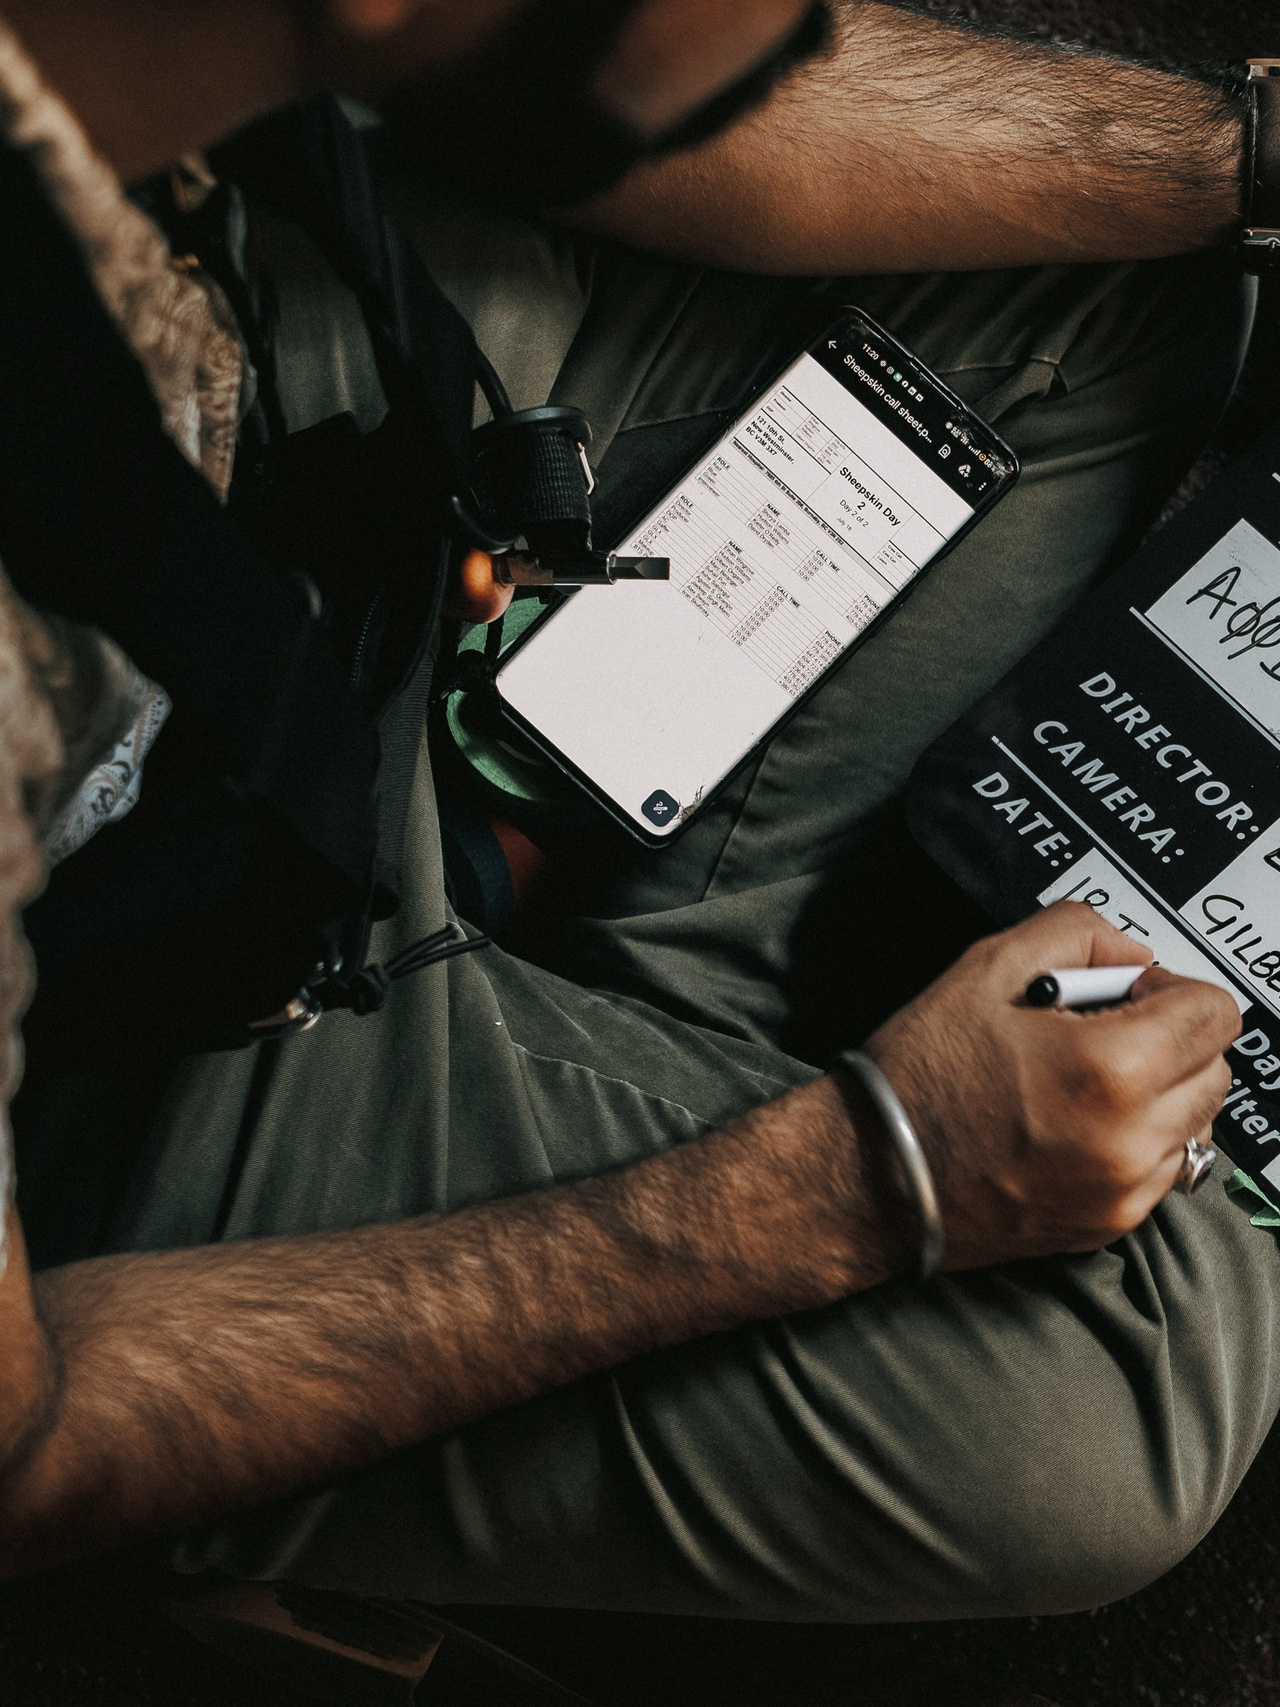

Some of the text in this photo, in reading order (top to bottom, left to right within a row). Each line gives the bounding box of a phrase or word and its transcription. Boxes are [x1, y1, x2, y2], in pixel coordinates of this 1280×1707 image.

[862, 343, 879, 360] 11:20
[843, 354, 884, 396] Sheepskin
[883, 393, 901, 409] call
[756, 415, 766, 425] 121
[766, 424, 778, 437] 10th
[745, 426, 777, 455] BC V3M 3X7
[750, 420, 763, 433] New
[762, 431, 794, 464] Westminster,
[839, 466, 900, 526] Sheepskin Day
[856, 501, 865, 510] 2
[766, 503, 780, 516] NAME
[839, 499, 852, 512] Day
[855, 515, 864, 523] of
[728, 540, 742, 554] NAME
[815, 549, 840, 572] CALL TIME
[776, 585, 800, 608] CALL TIME
[1079, 672, 1260, 840] DIRECTOR:
[1033, 720, 1185, 863] CAMERA:
[972, 772, 1073, 867] DATE:
